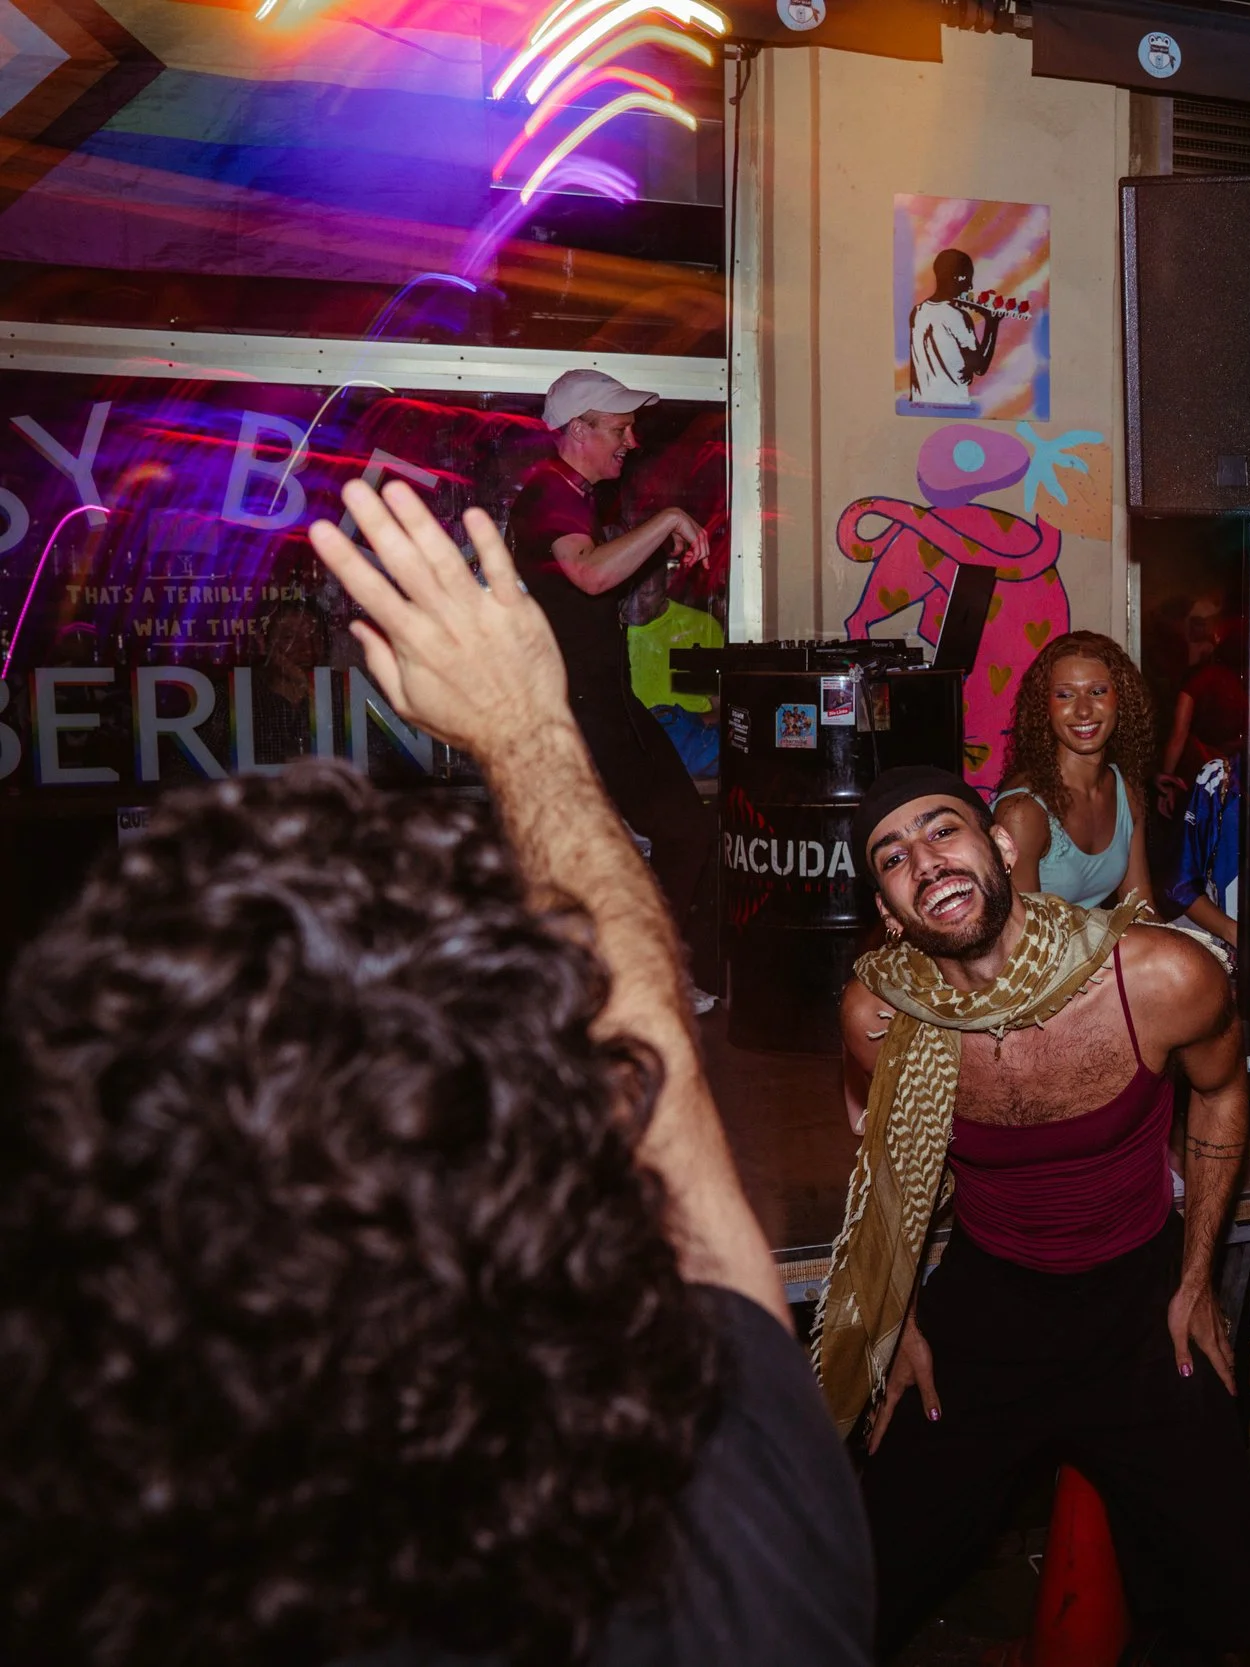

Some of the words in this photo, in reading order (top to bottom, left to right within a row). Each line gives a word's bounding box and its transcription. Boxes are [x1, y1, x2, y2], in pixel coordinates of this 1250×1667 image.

[66, 584, 134, 604] THAT'S
[142, 586, 155, 604] A
[163, 585, 253, 604] TERRIBLE
[133, 617, 197, 637] WHAT
[207, 616, 271, 637] TIME?
[0, 665, 435, 786] ERLIN
